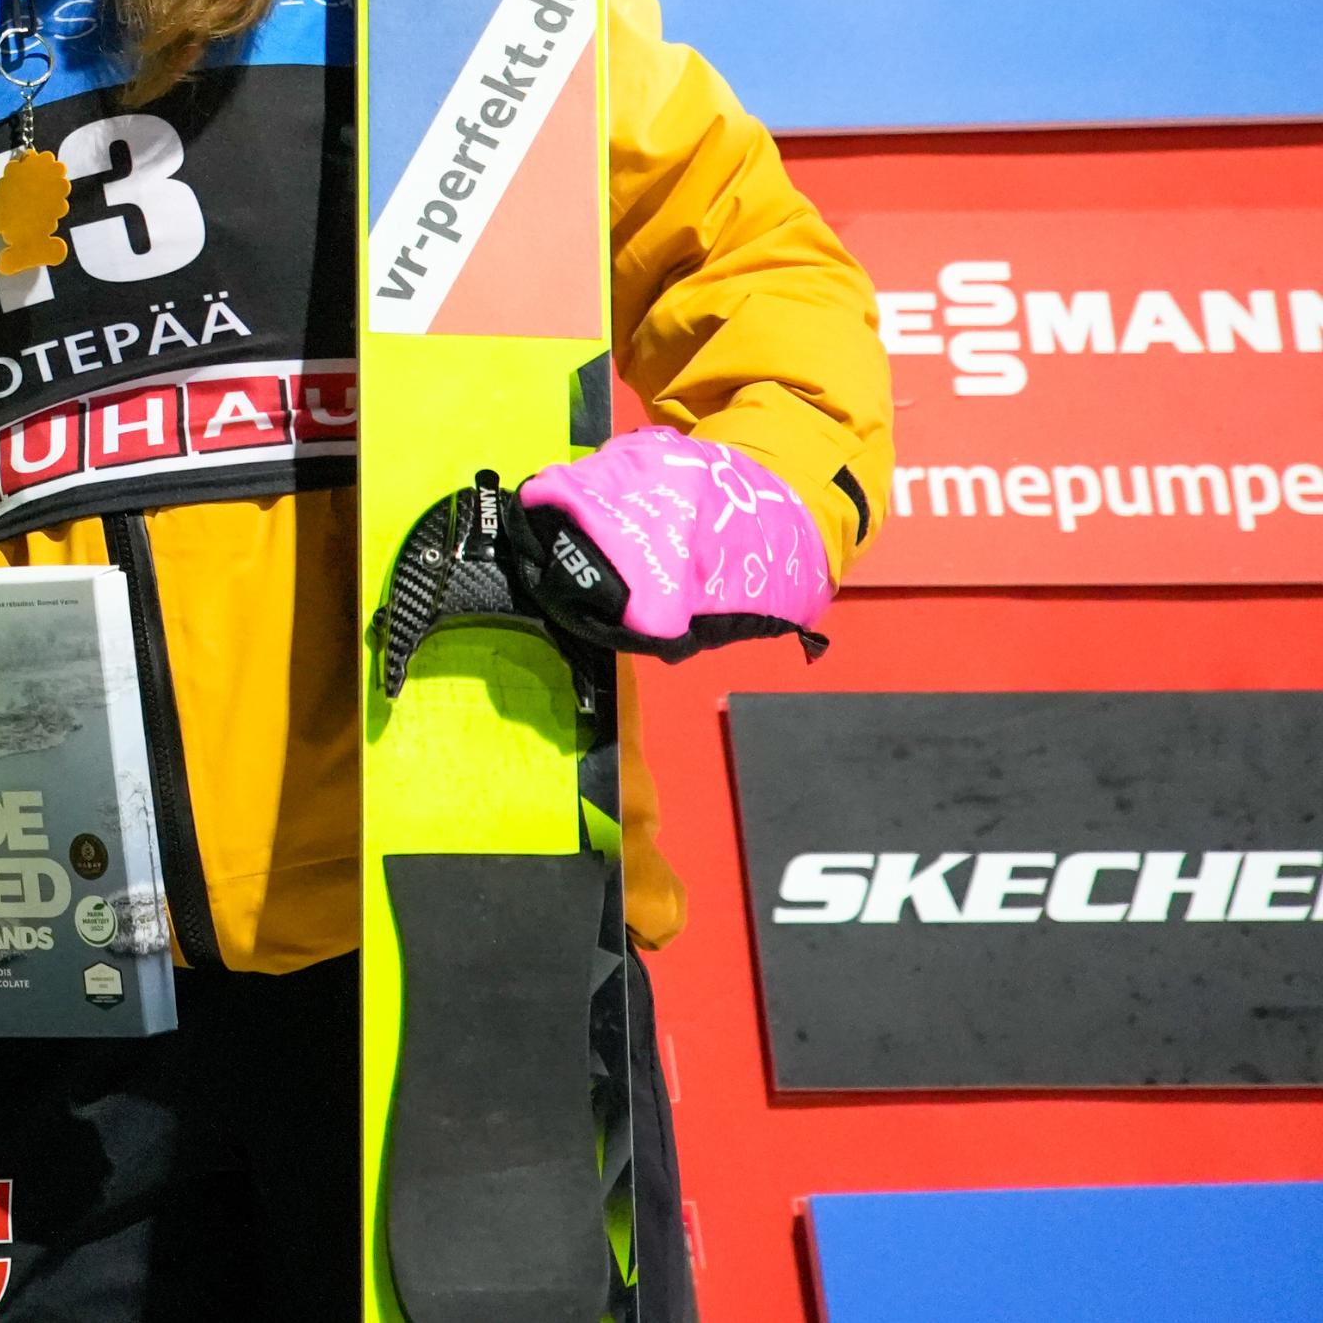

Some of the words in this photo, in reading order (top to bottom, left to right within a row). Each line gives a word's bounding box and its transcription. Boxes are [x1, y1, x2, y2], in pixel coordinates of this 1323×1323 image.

[481, 486, 497, 540] JENNY
[648, 483, 698, 521] ind
[552, 530, 602, 590] SEIZ
[772, 851, 1323, 924] SKECHE
